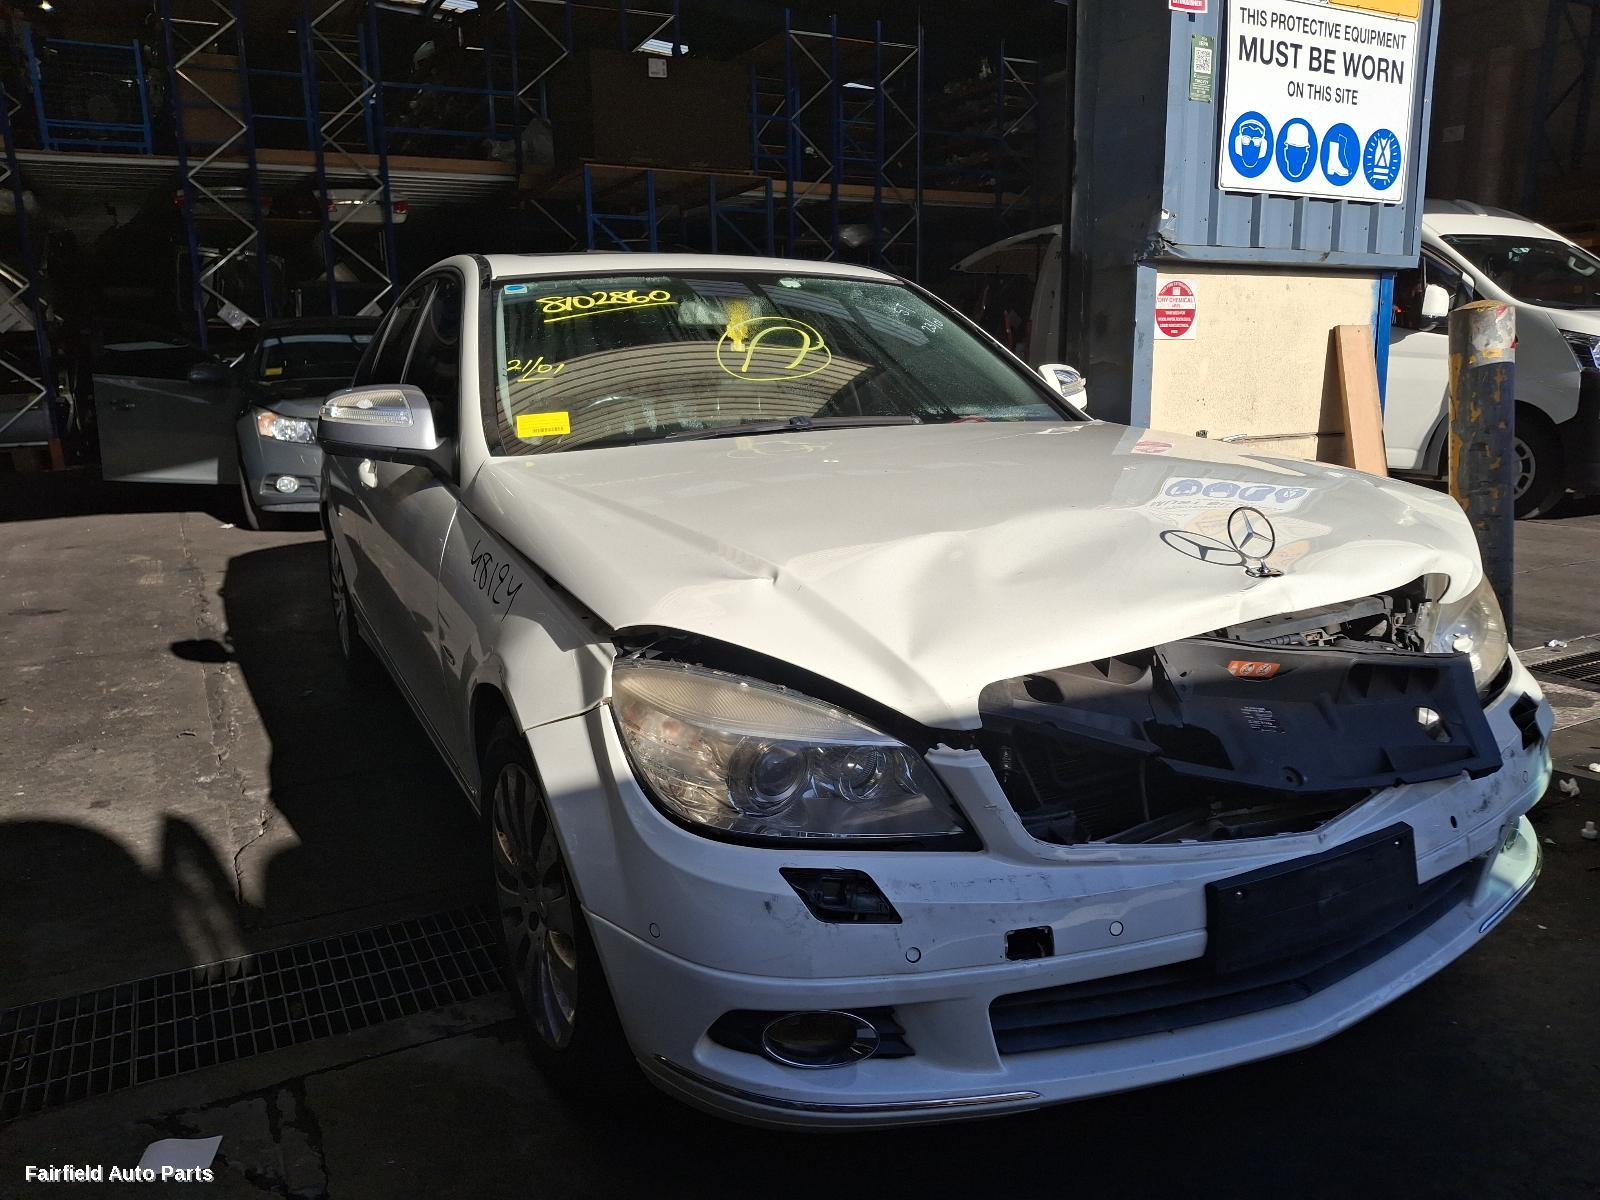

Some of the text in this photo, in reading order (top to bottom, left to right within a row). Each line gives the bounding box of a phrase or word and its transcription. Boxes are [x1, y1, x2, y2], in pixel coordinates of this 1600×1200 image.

[1239, 7, 1407, 51] THIS PROTECTIVE EQUIPMENT
[1238, 35, 1405, 85] MUST BE WORN
[1287, 81, 1359, 106] ON THIS SITE
